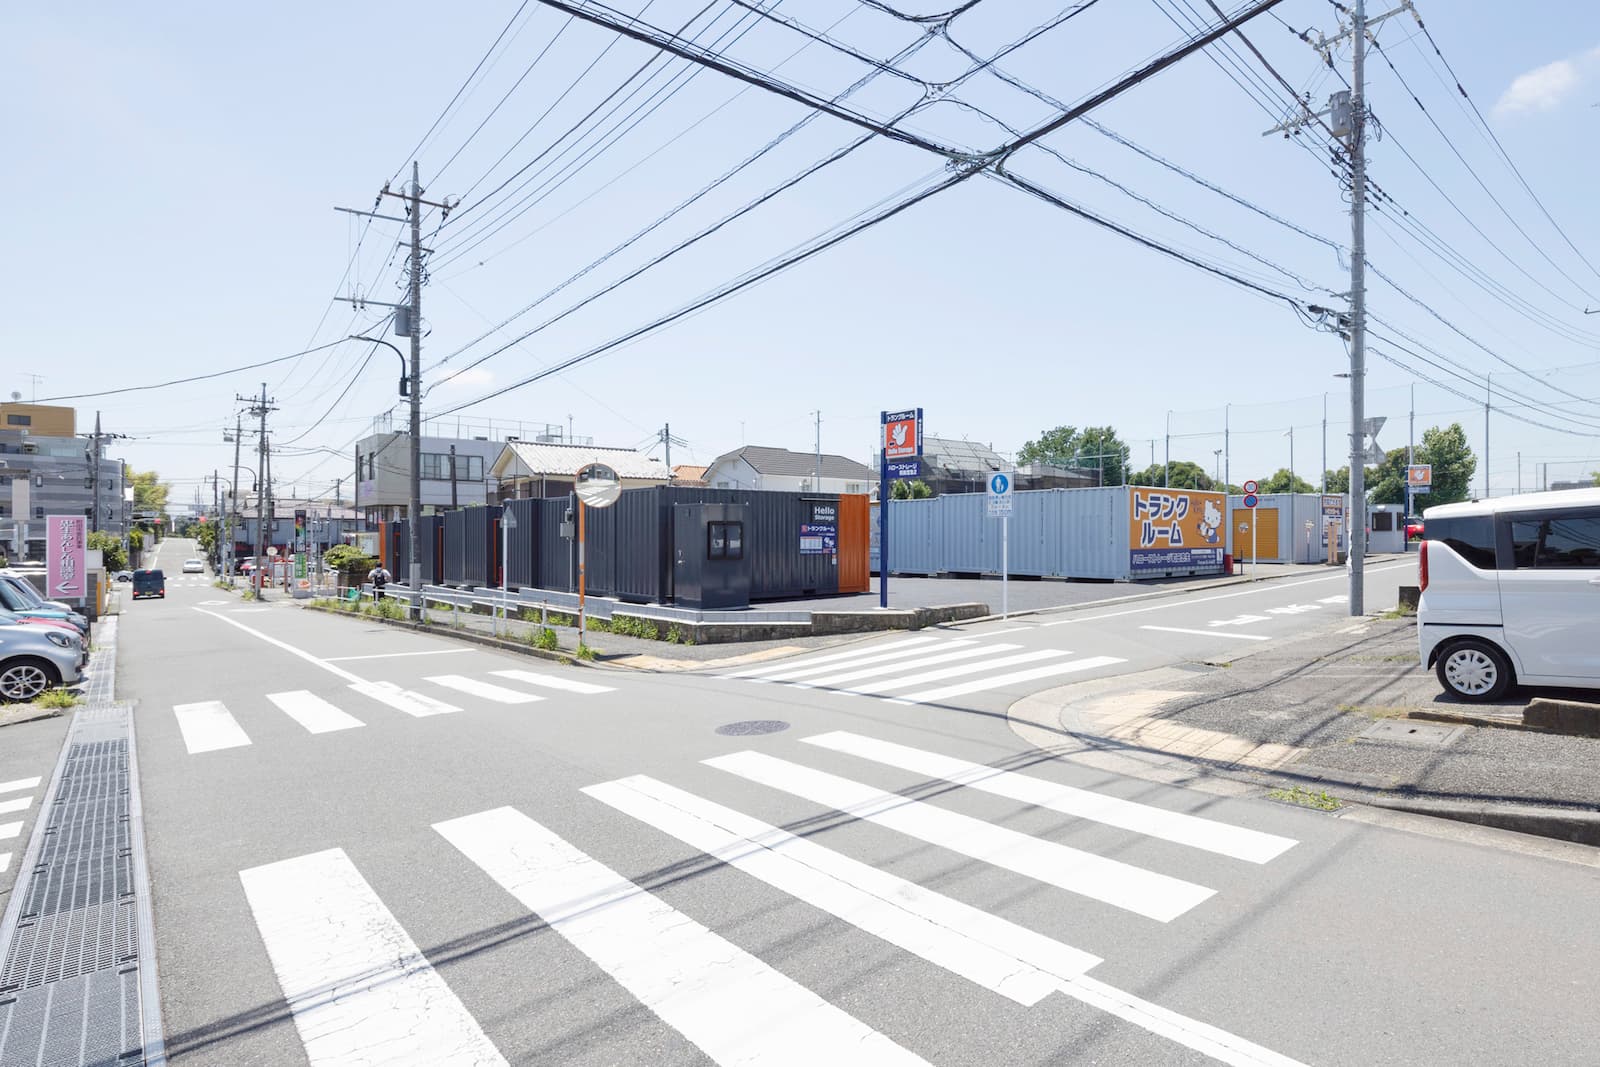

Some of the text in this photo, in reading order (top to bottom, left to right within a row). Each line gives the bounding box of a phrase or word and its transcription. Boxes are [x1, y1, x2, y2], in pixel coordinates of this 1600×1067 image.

[814, 506, 835, 515] Hello
[1133, 491, 1190, 521] トランク
[814, 514, 835, 522] Storage
[807, 525, 836, 533] トランクルーム
[1140, 519, 1184, 547] ルーム
